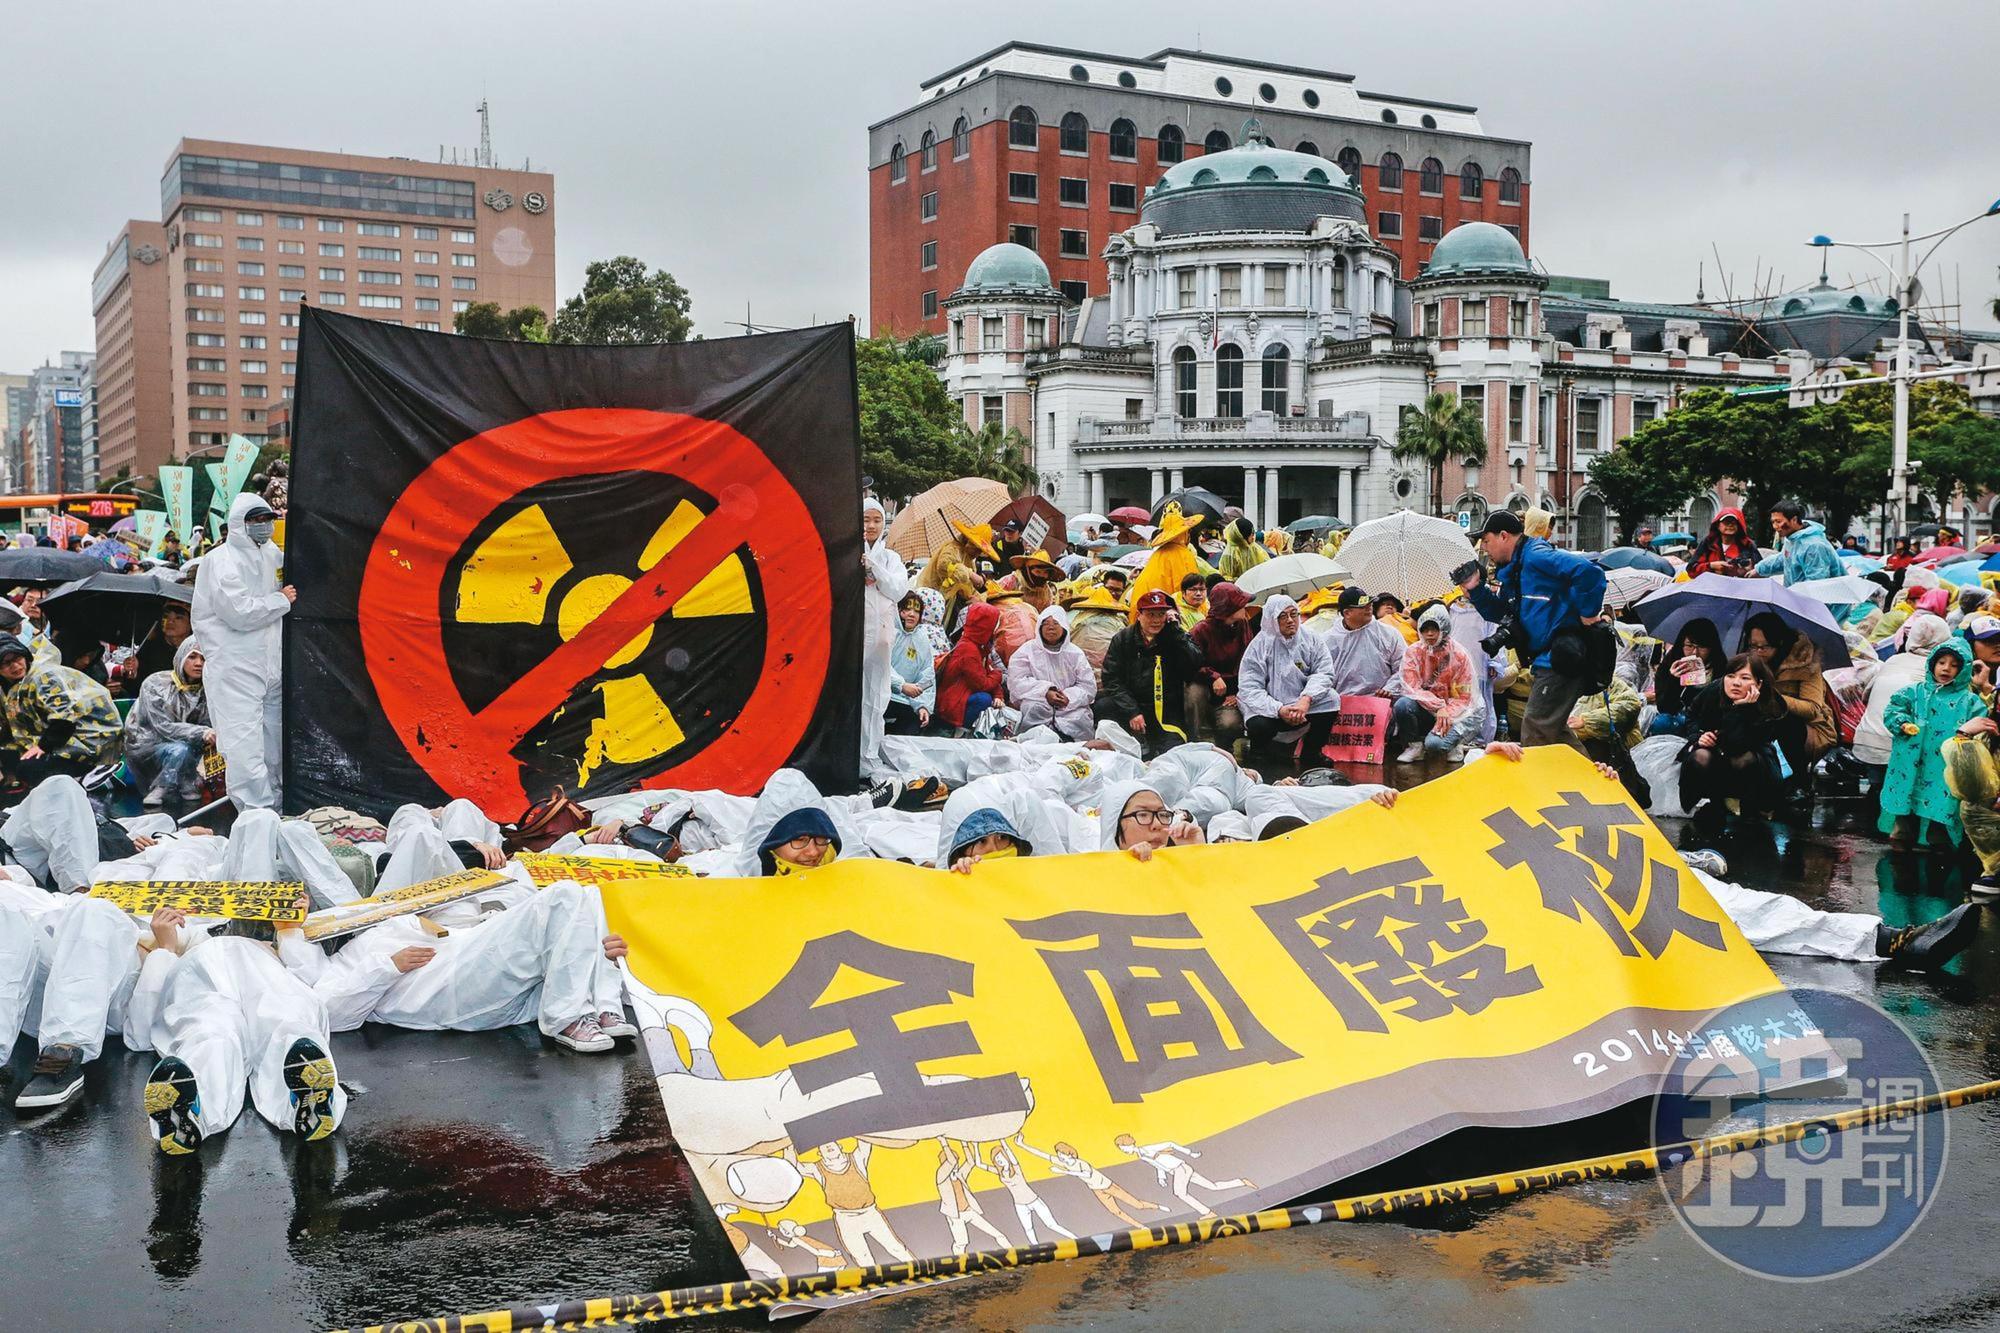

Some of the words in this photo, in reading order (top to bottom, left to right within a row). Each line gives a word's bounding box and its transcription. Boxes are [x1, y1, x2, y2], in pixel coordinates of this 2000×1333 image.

[91, 500, 113, 515] 276
[728, 791, 1726, 1152] 全面廢核
